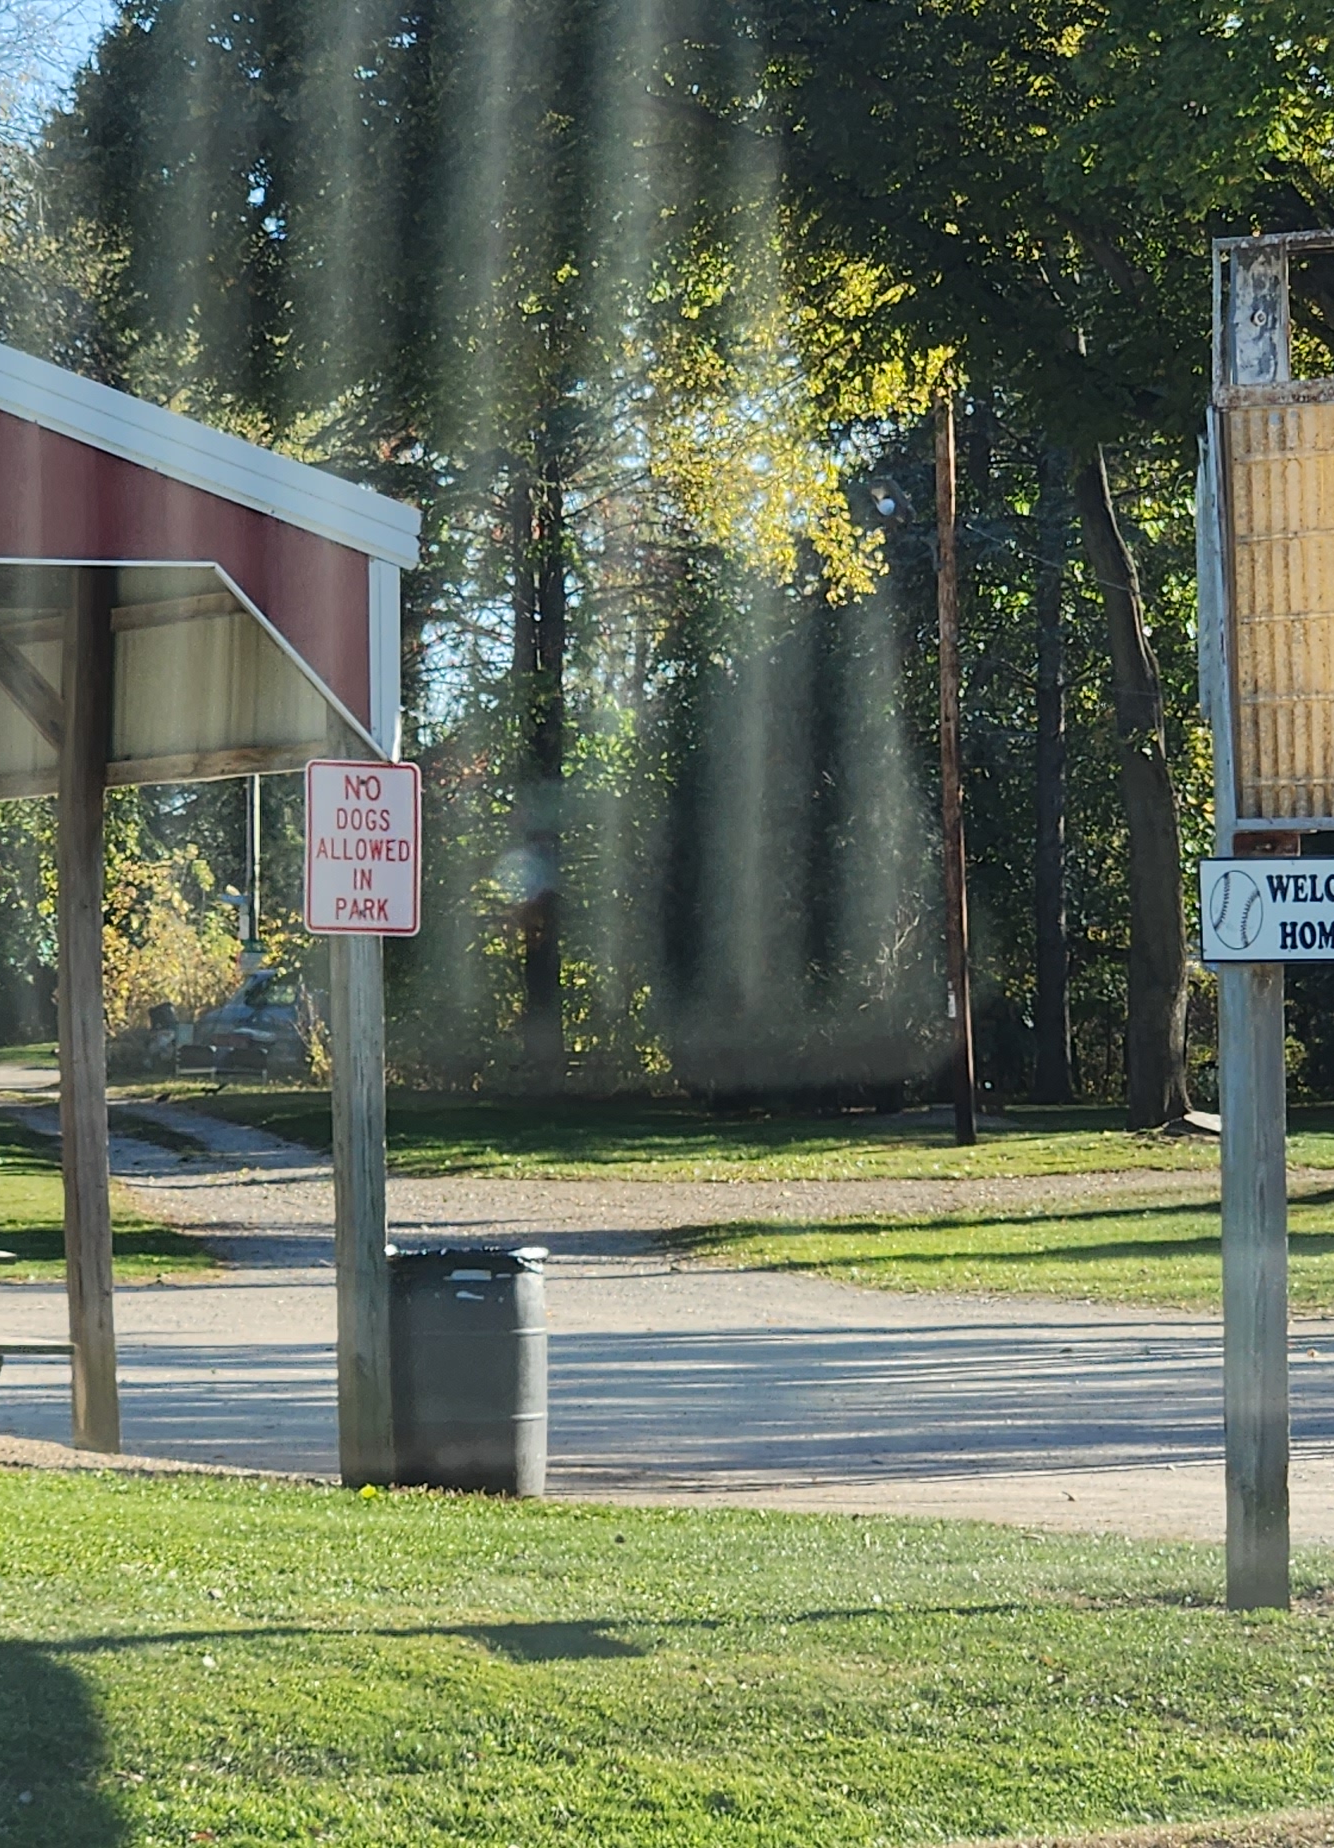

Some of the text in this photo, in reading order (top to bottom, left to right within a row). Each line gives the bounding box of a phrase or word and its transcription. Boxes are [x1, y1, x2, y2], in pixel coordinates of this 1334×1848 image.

[344, 775, 381, 801] NO
[336, 808, 390, 832] DOGS
[316, 838, 410, 862] ALLOWED
[353, 868, 373, 890] IN
[335, 898, 388, 922] PARK
